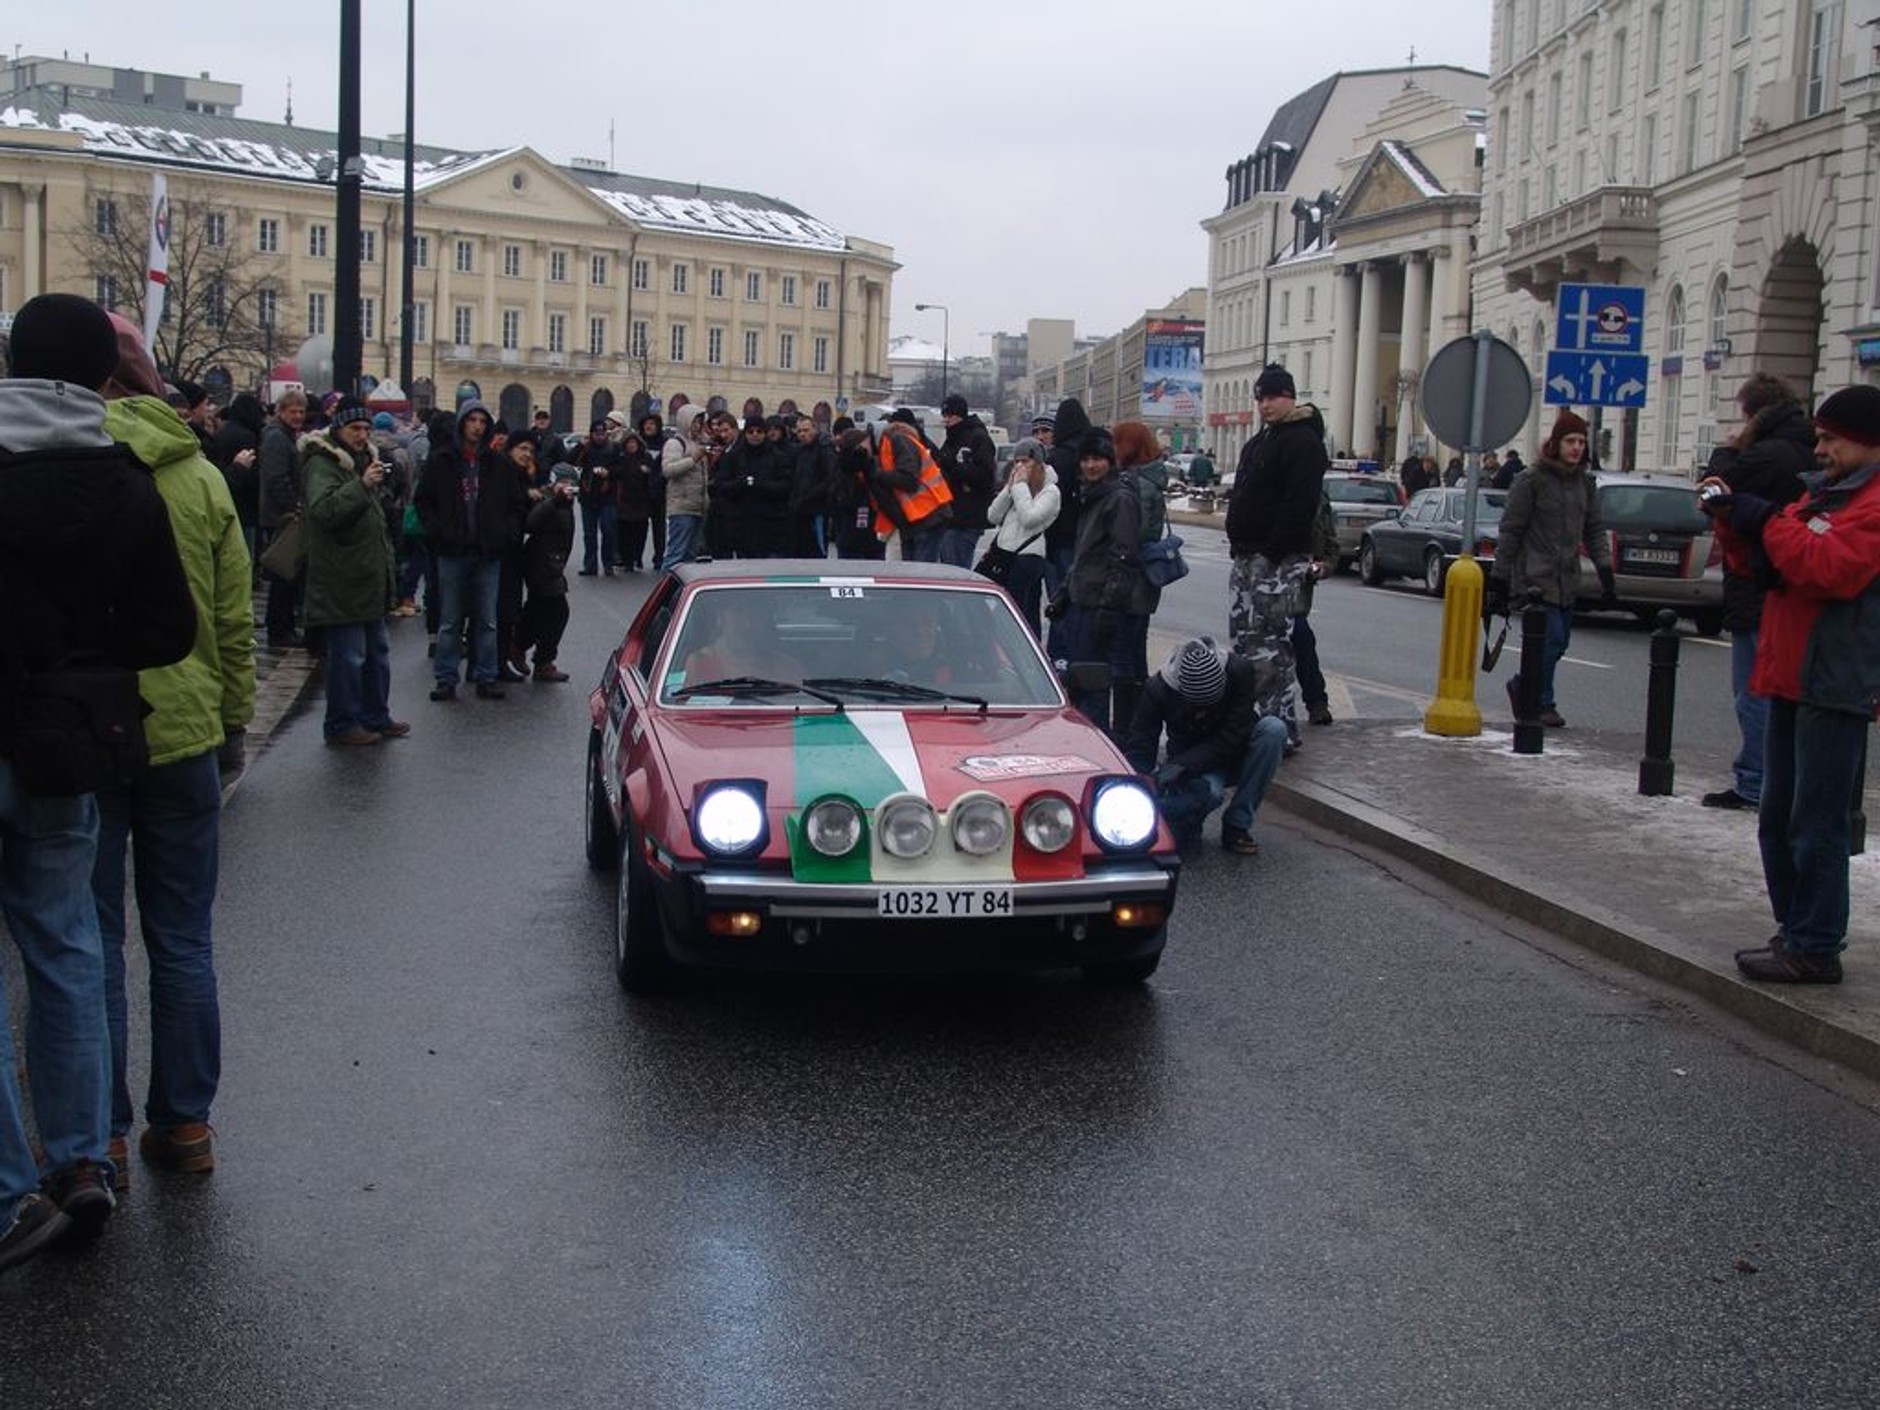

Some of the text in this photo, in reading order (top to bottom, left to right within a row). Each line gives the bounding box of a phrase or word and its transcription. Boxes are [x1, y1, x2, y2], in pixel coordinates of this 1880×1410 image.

[838, 587, 855, 598] 84
[882, 890, 1011, 914] 1032 YT 84
